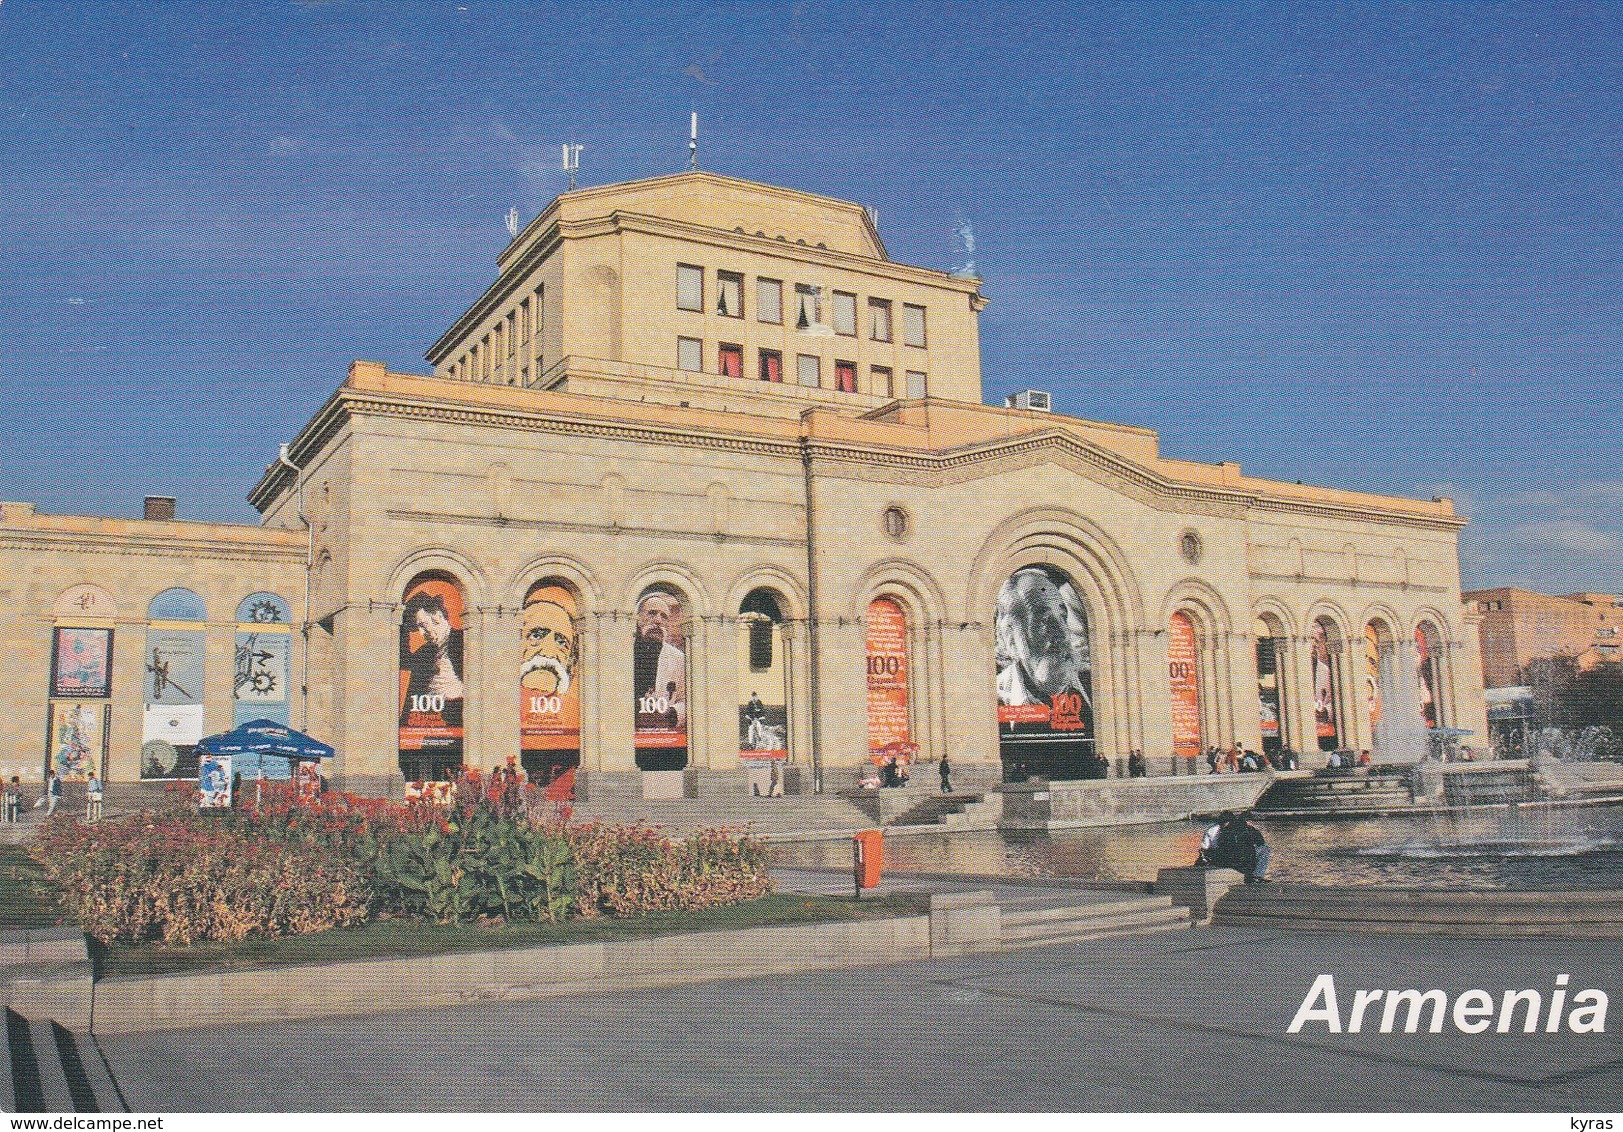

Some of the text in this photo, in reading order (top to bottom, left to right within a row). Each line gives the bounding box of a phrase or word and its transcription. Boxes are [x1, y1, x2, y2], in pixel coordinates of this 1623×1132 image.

[866, 656, 899, 675] 100
[410, 694, 445, 712] 100
[529, 696, 562, 714] 100
[638, 696, 670, 714] 100
[1050, 692, 1083, 714] 100
